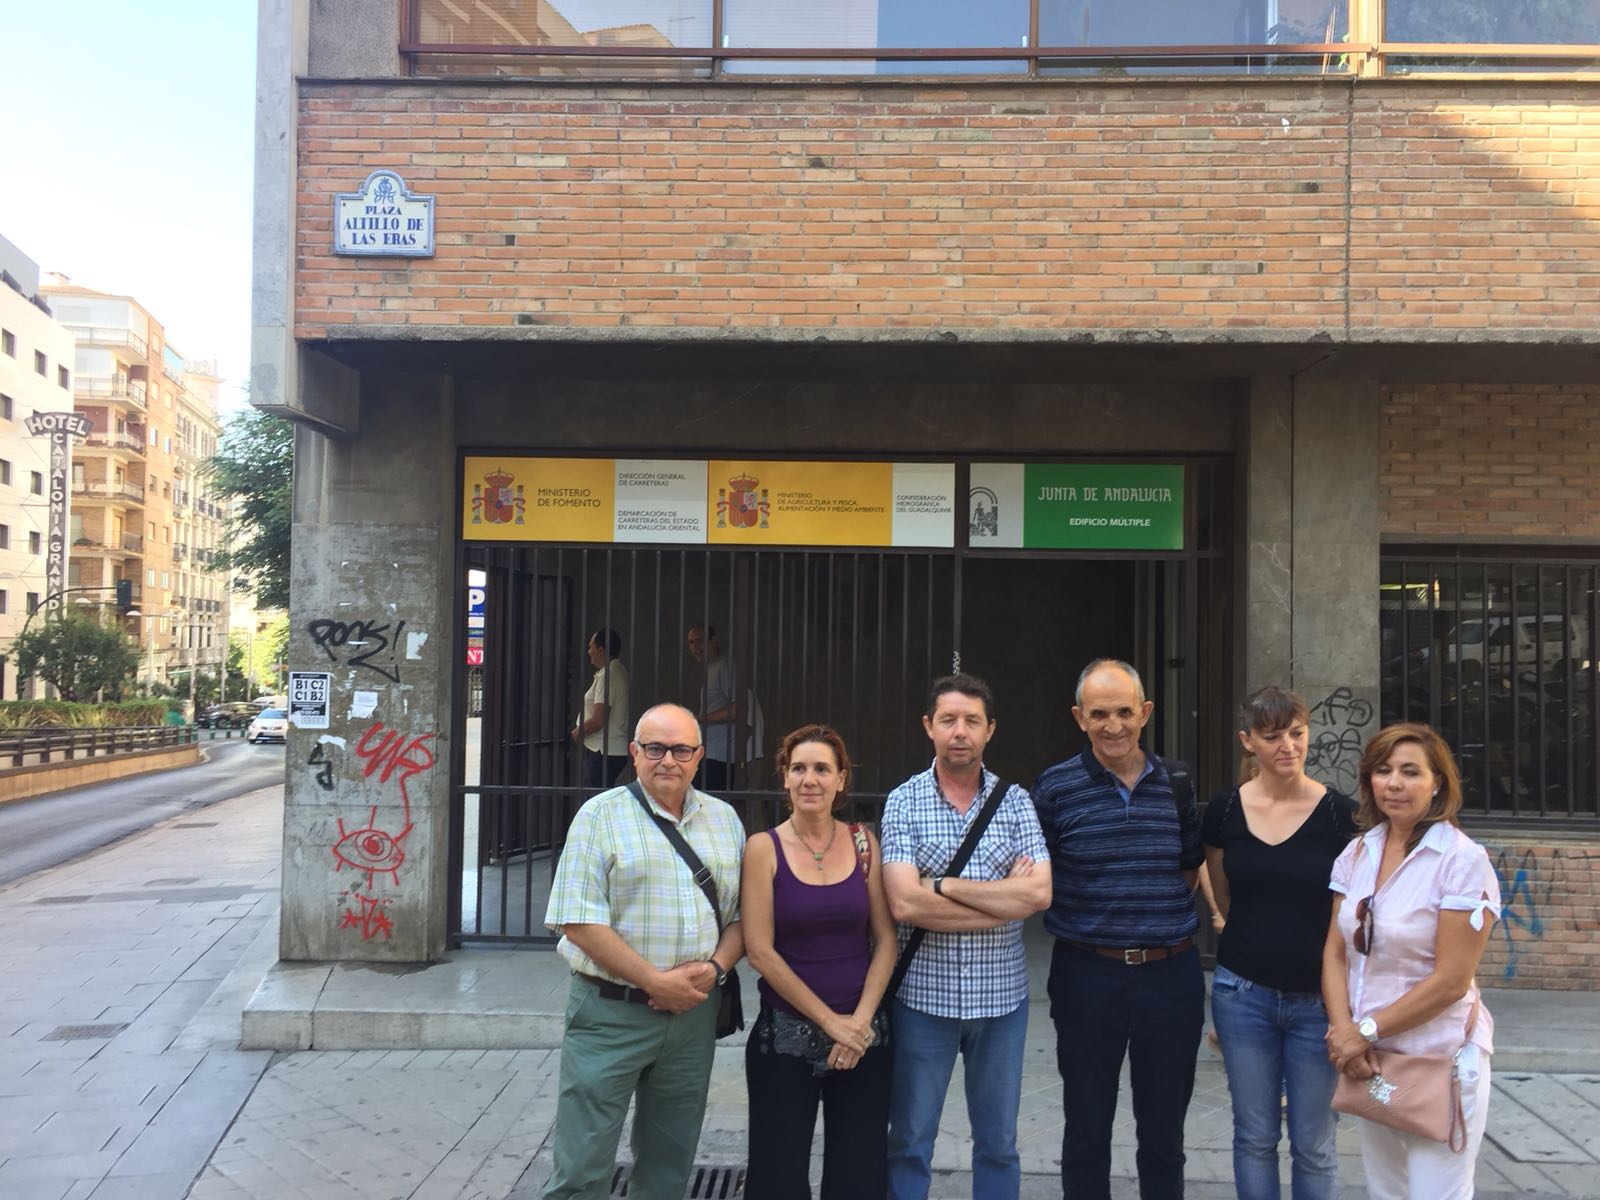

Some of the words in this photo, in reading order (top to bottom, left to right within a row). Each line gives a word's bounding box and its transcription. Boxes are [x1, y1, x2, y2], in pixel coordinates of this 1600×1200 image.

[365, 205, 402, 215] PLAZA
[344, 217, 400, 230] ALTILLO
[407, 218, 424, 231] DE
[352, 233, 376, 245] LAS
[383, 233, 416, 245] ERAS
[28, 414, 88, 437] HOTEL
[50, 433, 65, 537] CATALONIA
[537, 489, 591, 497] MINISTERIO
[1038, 487, 1077, 501] JUNTA
[1083, 487, 1099, 501] DE
[537, 499, 550, 507] DE
[552, 499, 601, 508] FOMENTO
[1069, 517, 1108, 526] EDIFICIO
[1109, 517, 1151, 527] MÚLTIPLE
[468, 588, 485, 612] P
[295, 680, 308, 690] B1
[310, 680, 324, 690] C2
[294, 691, 308, 701] C1
[310, 691, 324, 701] B2
